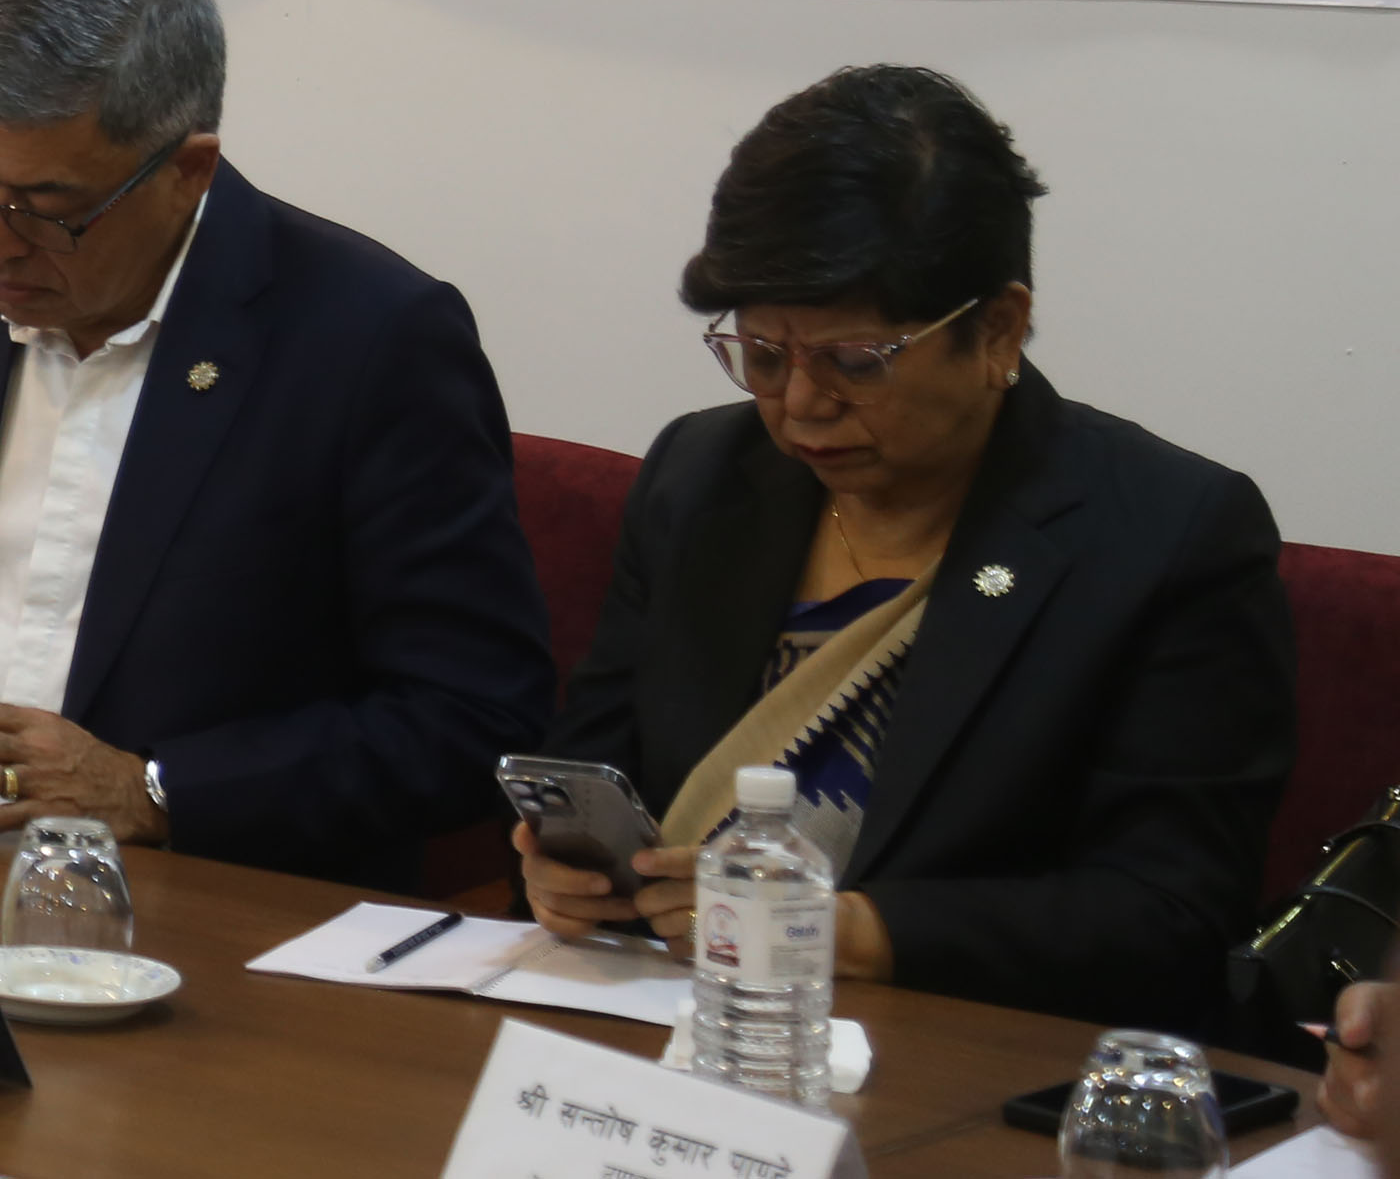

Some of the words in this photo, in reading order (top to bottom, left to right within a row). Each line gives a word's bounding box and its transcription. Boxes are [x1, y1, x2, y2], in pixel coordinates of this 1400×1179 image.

[517, 1083, 550, 1119] श्री
[559, 1101, 639, 1147] सन्तोष
[648, 1126, 719, 1169] कुमार
